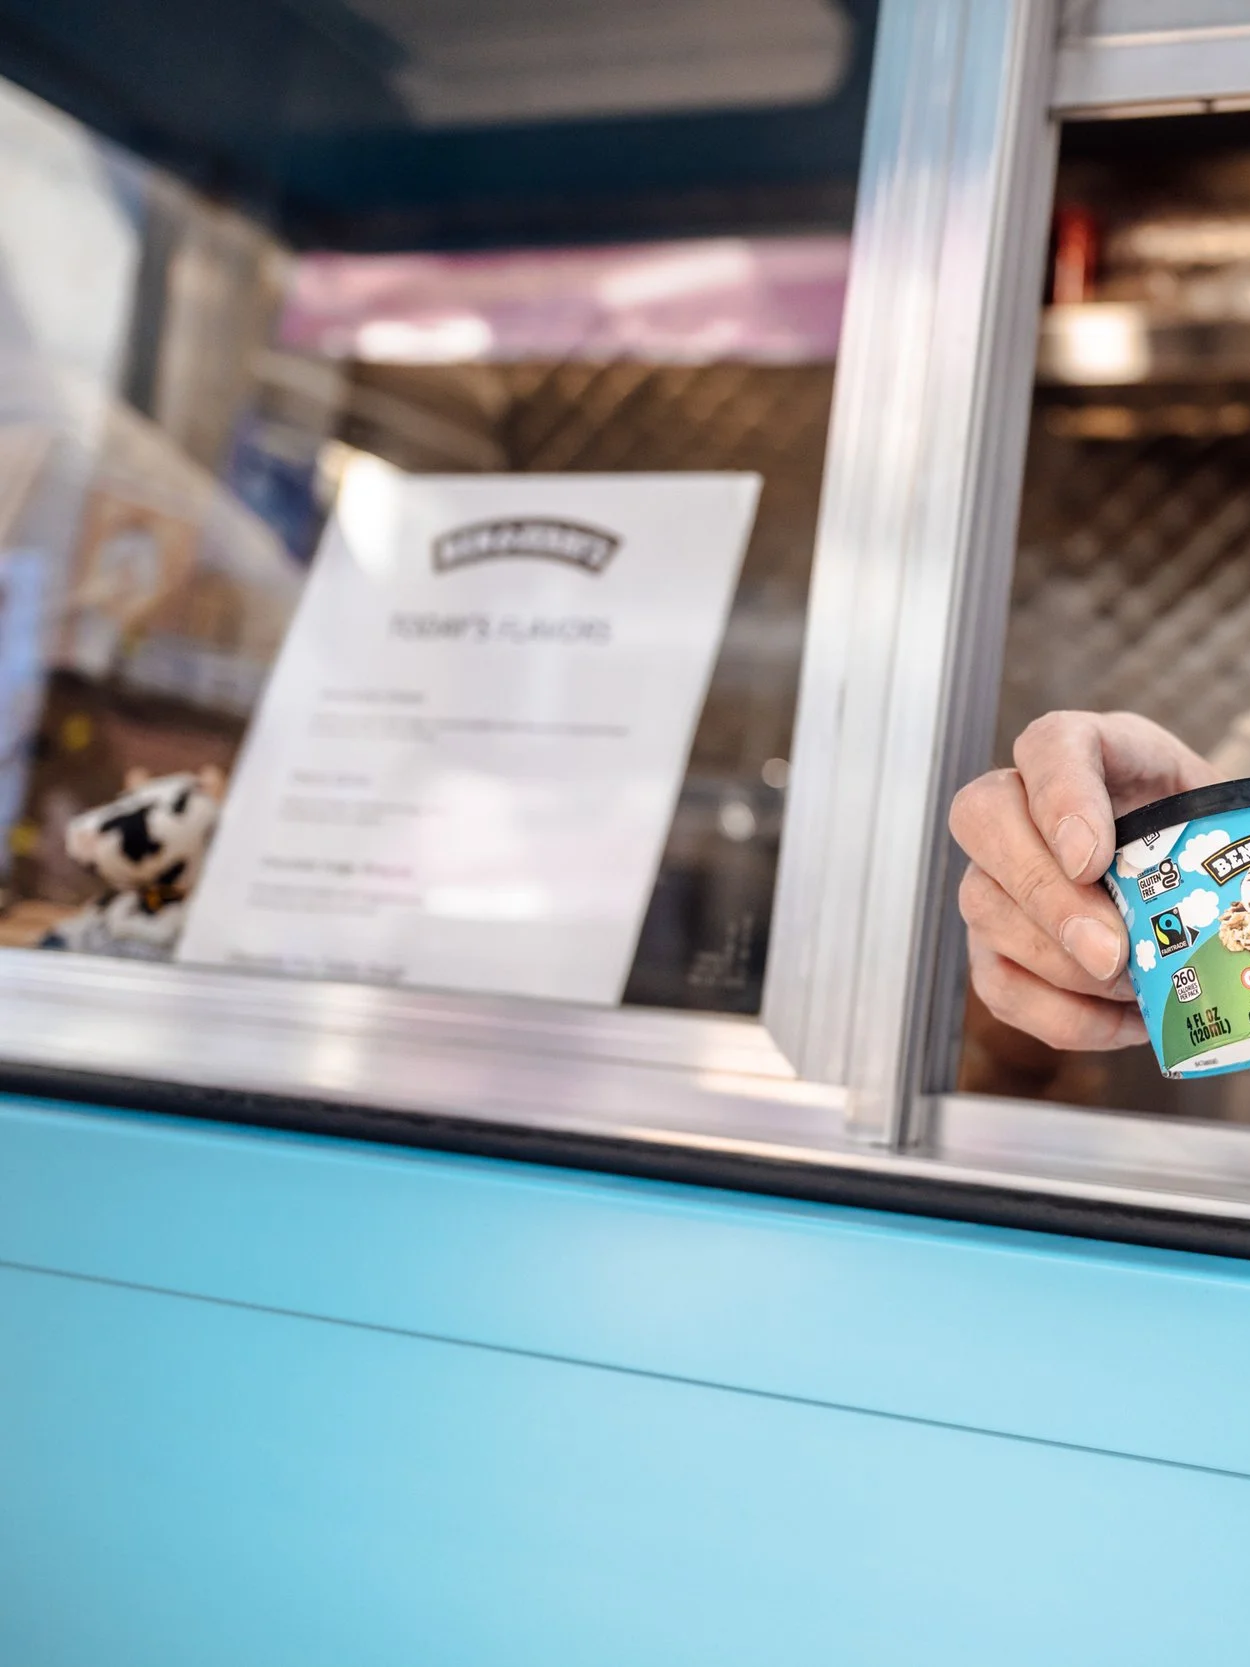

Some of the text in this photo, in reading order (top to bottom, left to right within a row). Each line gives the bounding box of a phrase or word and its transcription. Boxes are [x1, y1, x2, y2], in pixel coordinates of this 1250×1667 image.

[1140, 872, 1161, 889] GLUTEN
[1142, 886, 1156, 898] FREE
[1161, 940, 1188, 955] FAIRTRADE
[1173, 969, 1196, 988] 260
[1177, 982, 1198, 995] CALORIES
[1180, 989, 1199, 1001] PER PACK
[1186, 1006, 1220, 1030] 4 FL OZ
